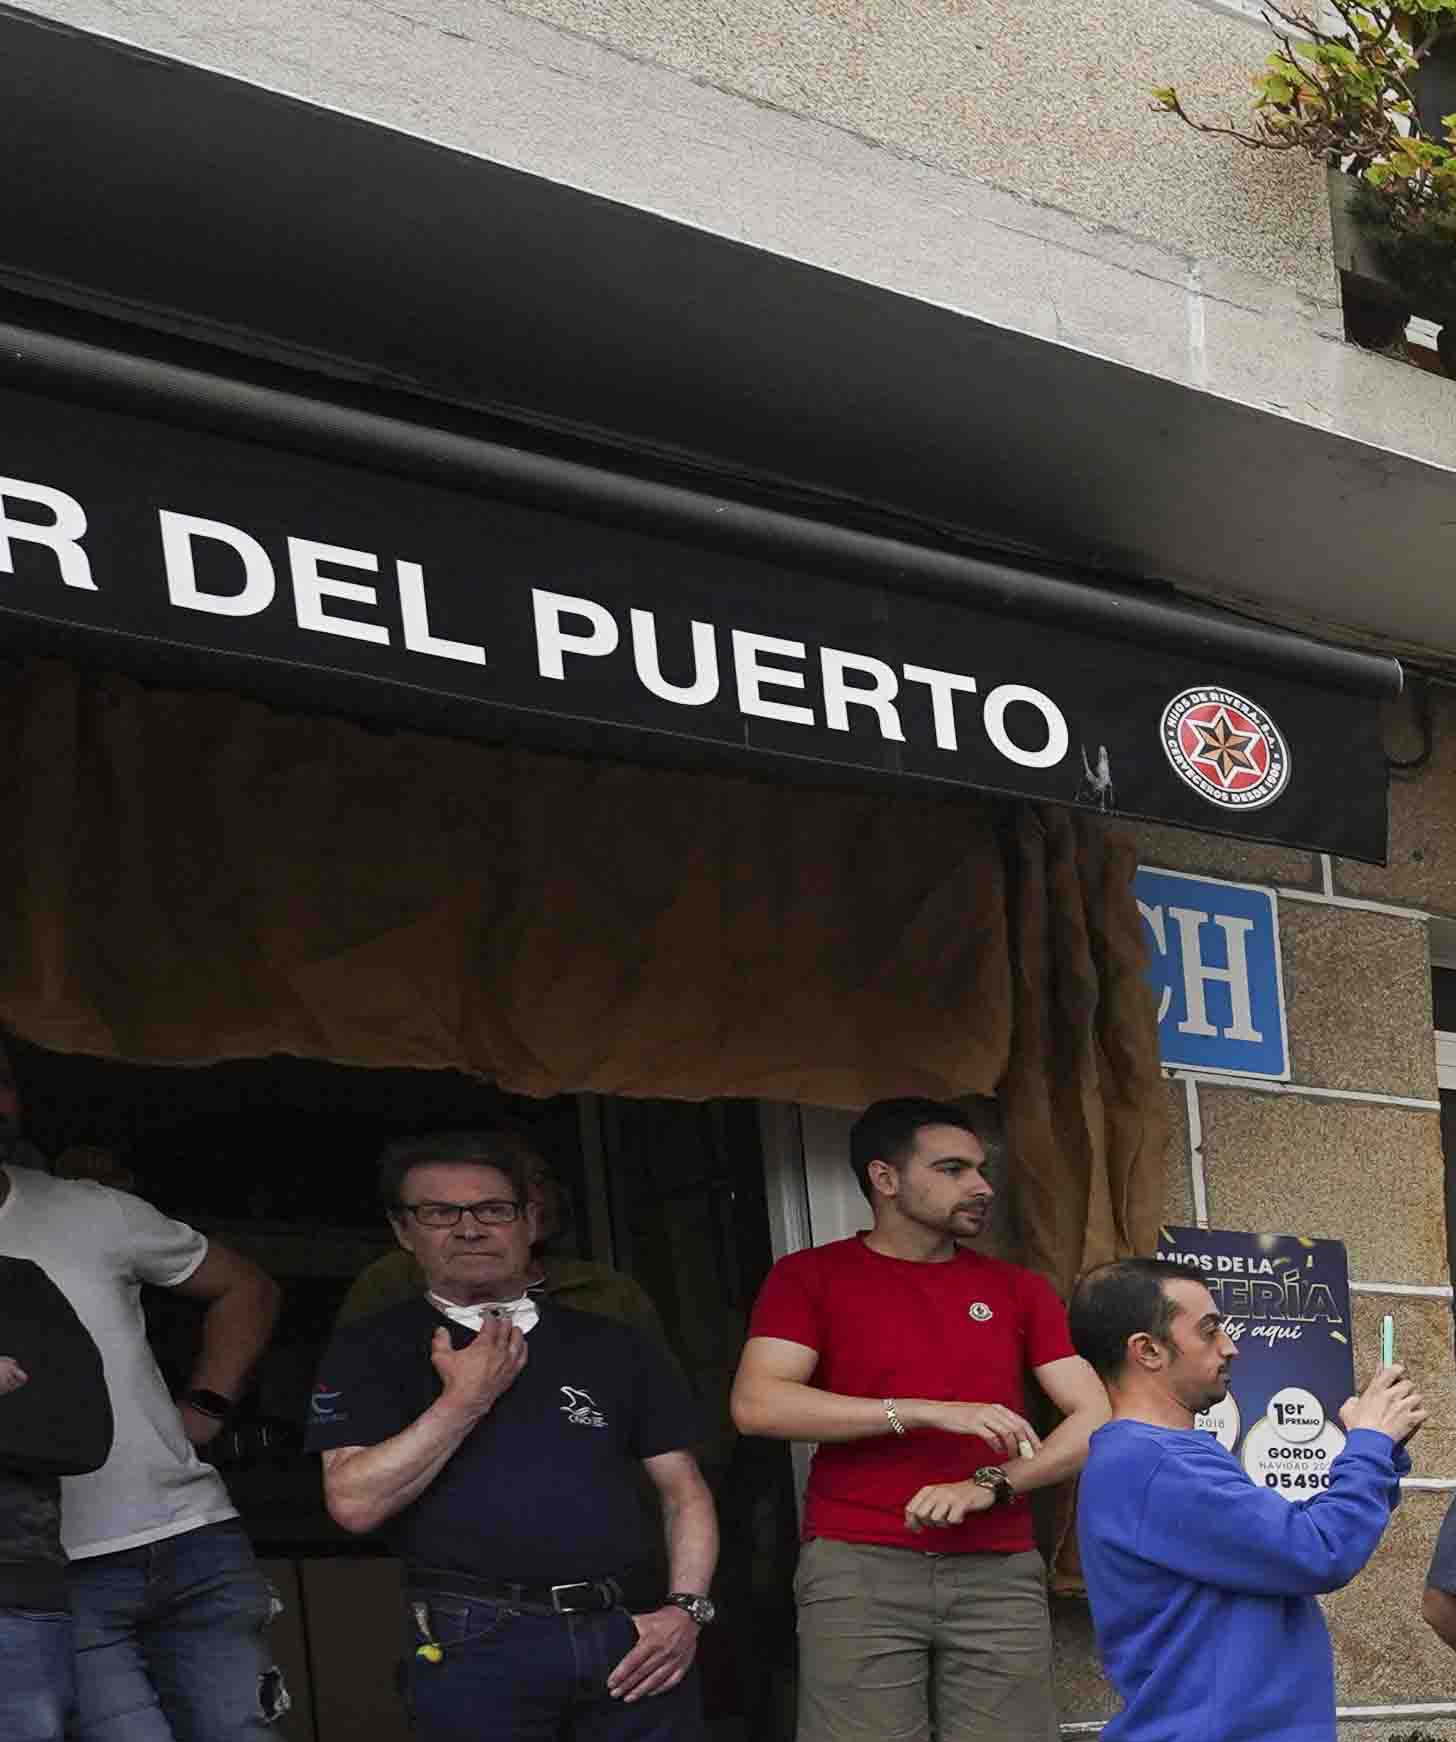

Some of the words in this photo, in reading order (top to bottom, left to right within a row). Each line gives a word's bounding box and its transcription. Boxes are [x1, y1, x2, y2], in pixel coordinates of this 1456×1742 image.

[159, 509, 487, 666] DEL
[532, 587, 1069, 768] PUERTO
[1190, 692, 1208, 704] DE
[1168, 740, 1229, 801] CERVECEROS
[1231, 787, 1268, 802] DESDE
[1217, 1255, 1244, 1273] DE
[1247, 1257, 1274, 1275] LA
[1285, 1417, 1321, 1426] PREMIO
[1267, 1447, 1327, 1460] GORDO
[1258, 1461, 1310, 1471] NAVIDAD
